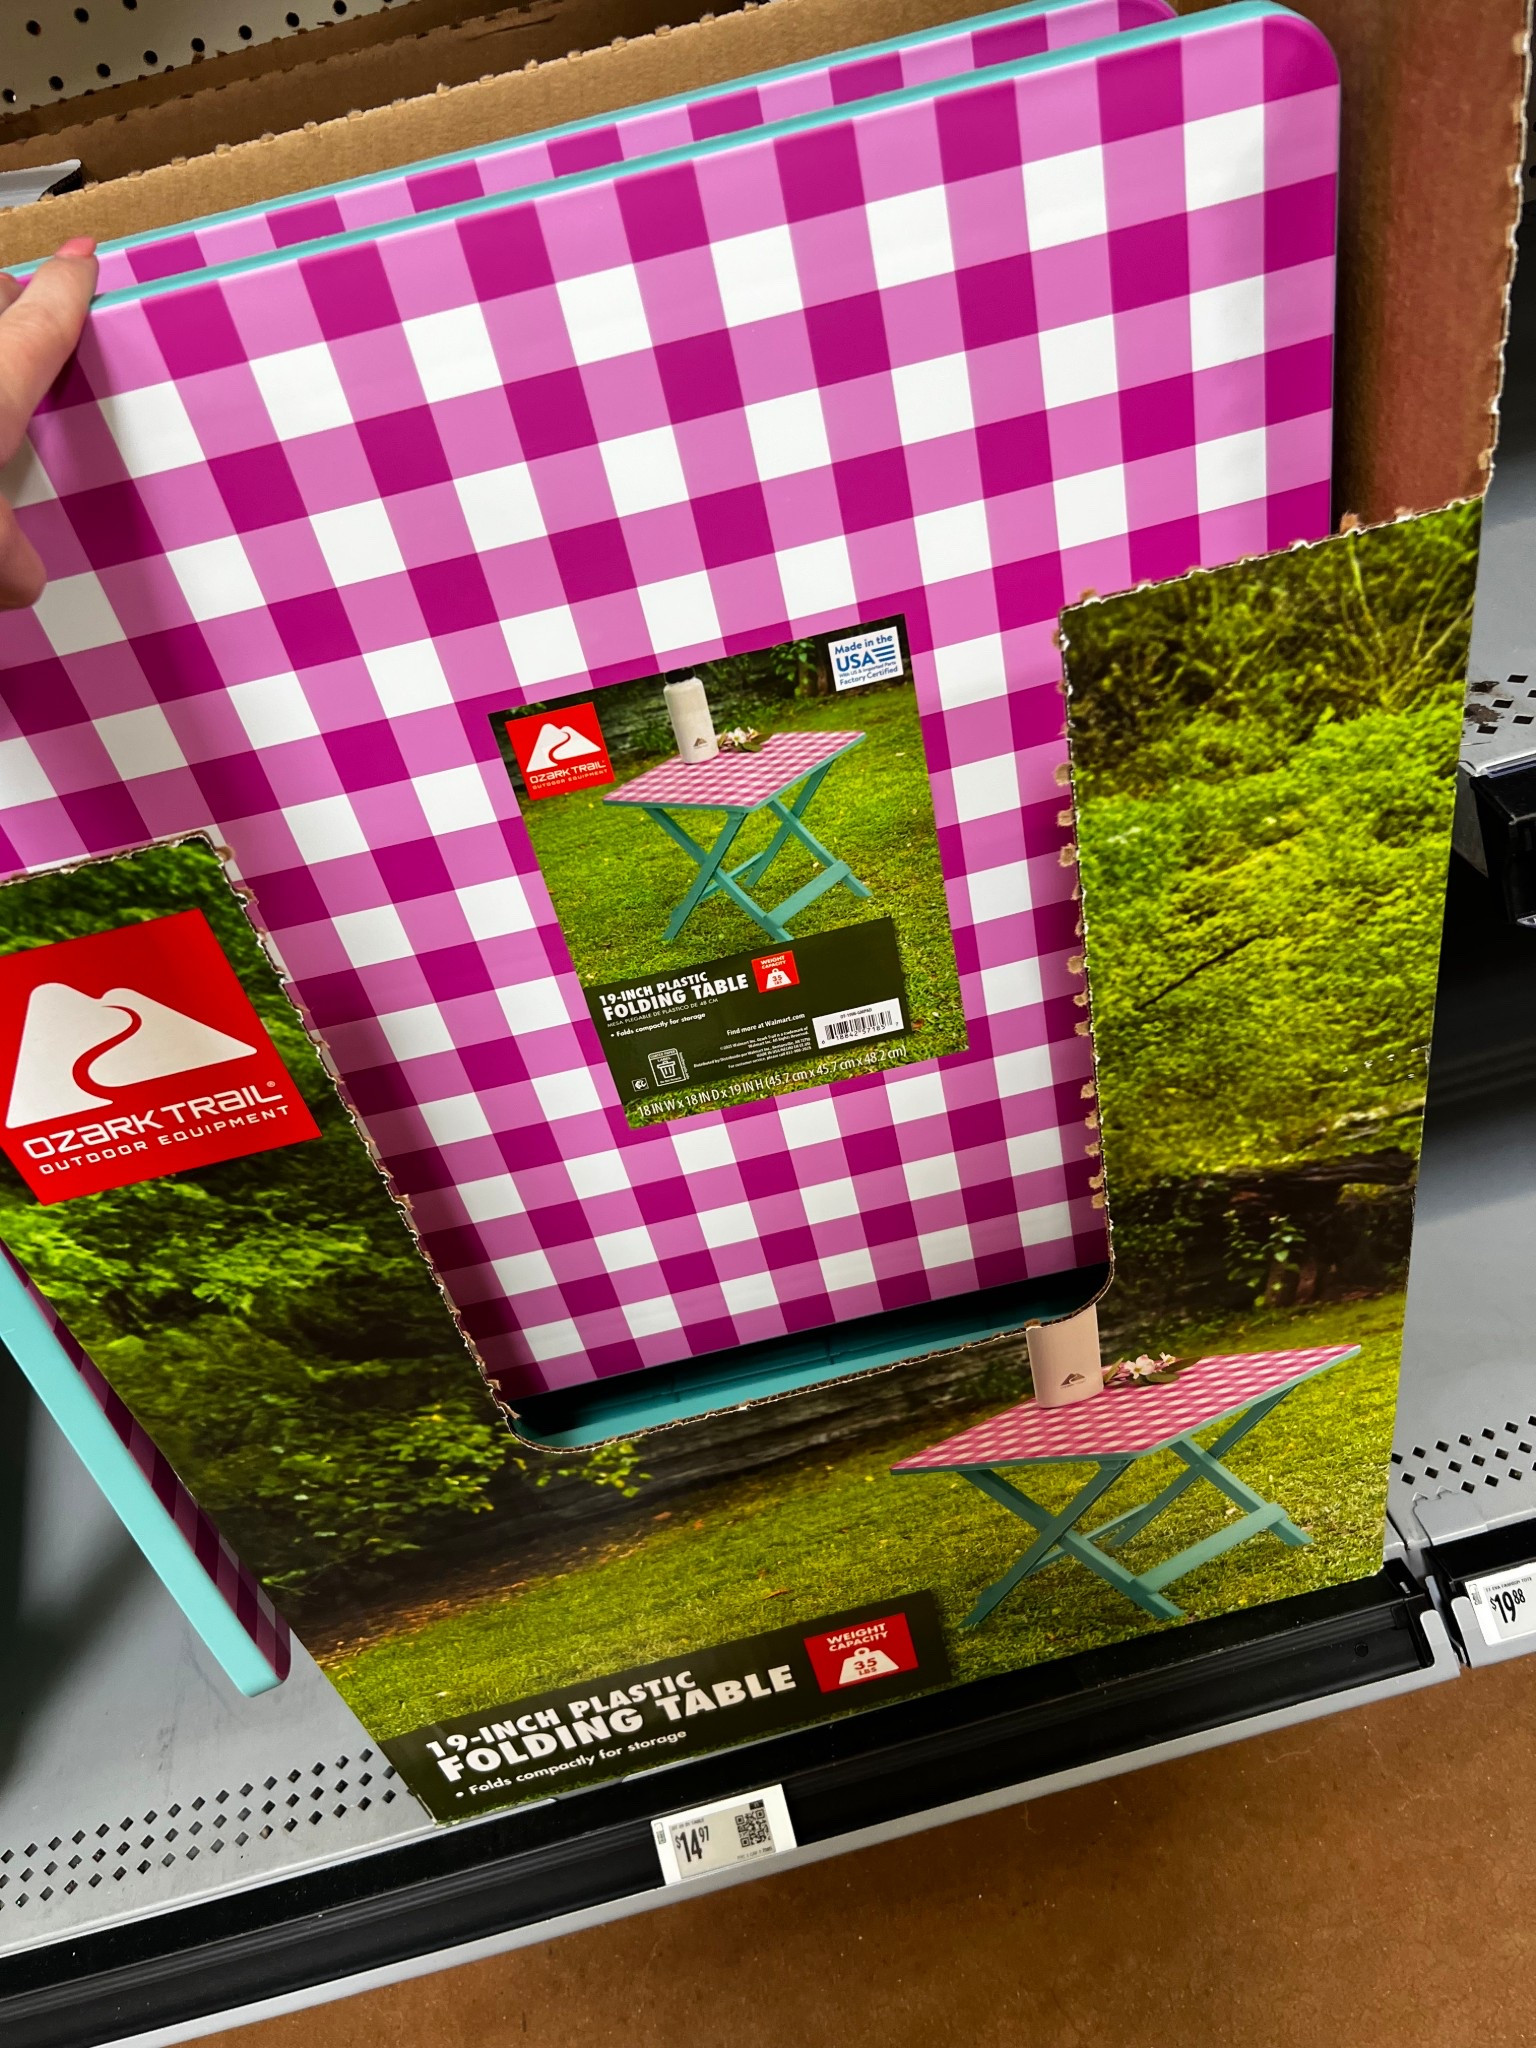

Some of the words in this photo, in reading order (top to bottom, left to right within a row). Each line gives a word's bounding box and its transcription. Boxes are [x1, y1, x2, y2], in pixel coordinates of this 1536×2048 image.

[835, 642, 862, 655] Made
[865, 639, 874, 647] in
[876, 635, 893, 644] the
[836, 651, 875, 672] USA
[840, 676, 866, 685] Factory
[866, 666, 898, 678] Certified
[529, 768, 571, 784] OZARK
[532, 779, 565, 790] OUTDOOR
[568, 769, 608, 782] EQUIPMENT
[760, 955, 785, 965] WEIGHT
[761, 960, 786, 969] CAPACITY
[599, 985, 653, 1007] 19-INCH
[656, 971, 708, 992] PLASTIC
[602, 989, 687, 1022] FOLDING
[691, 973, 749, 1000] TABLE
[607, 1020, 624, 1028] MESA
[625, 1014, 651, 1024] PLEGABLE
[616, 1027, 634, 1037] Folds
[635, 1020, 668, 1032] compactly
[669, 1018, 680, 1026] for
[681, 1012, 706, 1024] storage
[727, 1028, 740, 1036] Find
[741, 1025, 757, 1033] more
[764, 1013, 805, 1027] Walmart.com
[836, 1031, 858, 1040] 18842
[862, 1024, 886, 1034] 57185
[638, 1105, 651, 1117] 18
[651, 1102, 664, 1114] IN
[664, 1099, 675, 1111] W
[677, 1100, 684, 1109] x
[685, 1094, 699, 1106] 18
[699, 1092, 711, 1103] IN
[711, 1089, 719, 1100] D
[721, 1090, 728, 1099] x
[728, 1083, 742, 1097] 19
[742, 1081, 755, 1093] IN
[755, 1080, 764, 1091] H
[765, 1073, 789, 1090] (45.7
[792, 1070, 807, 1081] cm
[808, 1070, 815, 1078] x
[816, 1062, 836, 1077] 45.7
[840, 1060, 855, 1070] cm
[856, 1058, 863, 1066] x
[864, 1050, 885, 1065] 48.2
[888, 1045, 907, 1059] cm)
[22, 1109, 164, 1159] OZARK
[38, 1140, 149, 1175] OUTDOOR
[157, 1105, 289, 1147] EQUIPMENT
[826, 1622, 886, 1644] WEIGHT
[829, 1631, 888, 1652] CAPACITY
[854, 1657, 877, 1670] 35
[859, 1667, 877, 1676] LBS
[426, 1708, 561, 1758] 19-INCH
[568, 1670, 696, 1719] PLASTIC
[437, 1708, 643, 1782] FOLDING
[655, 1664, 797, 1722] TABLE
[468, 1777, 512, 1796] Folds
[516, 1753, 595, 1783] compactly
[599, 1746, 623, 1760] for
[628, 1730, 687, 1752] storage
